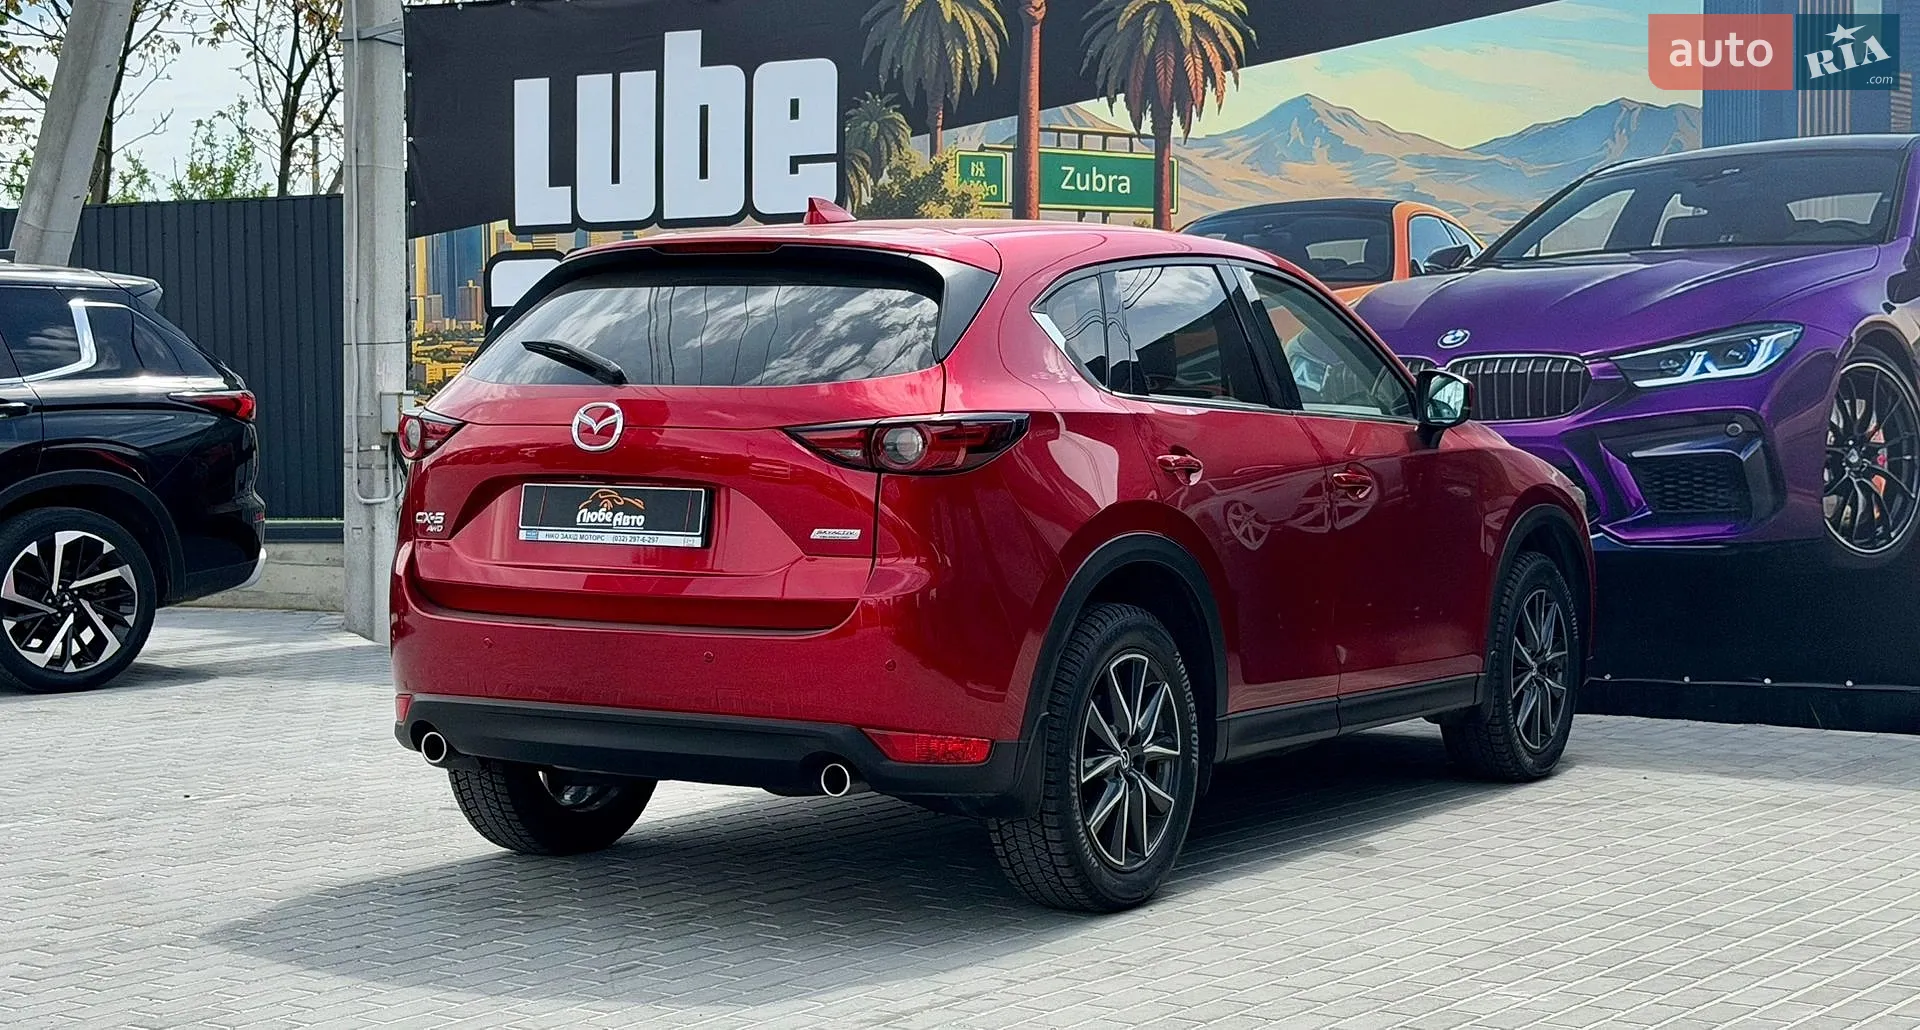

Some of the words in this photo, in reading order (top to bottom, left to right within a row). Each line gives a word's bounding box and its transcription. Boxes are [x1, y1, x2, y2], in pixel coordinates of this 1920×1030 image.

[1060, 167, 1131, 194] Zubra
[415, 511, 446, 524] CX-5
[576, 508, 613, 523] Любе
[612, 511, 645, 527] Авто
